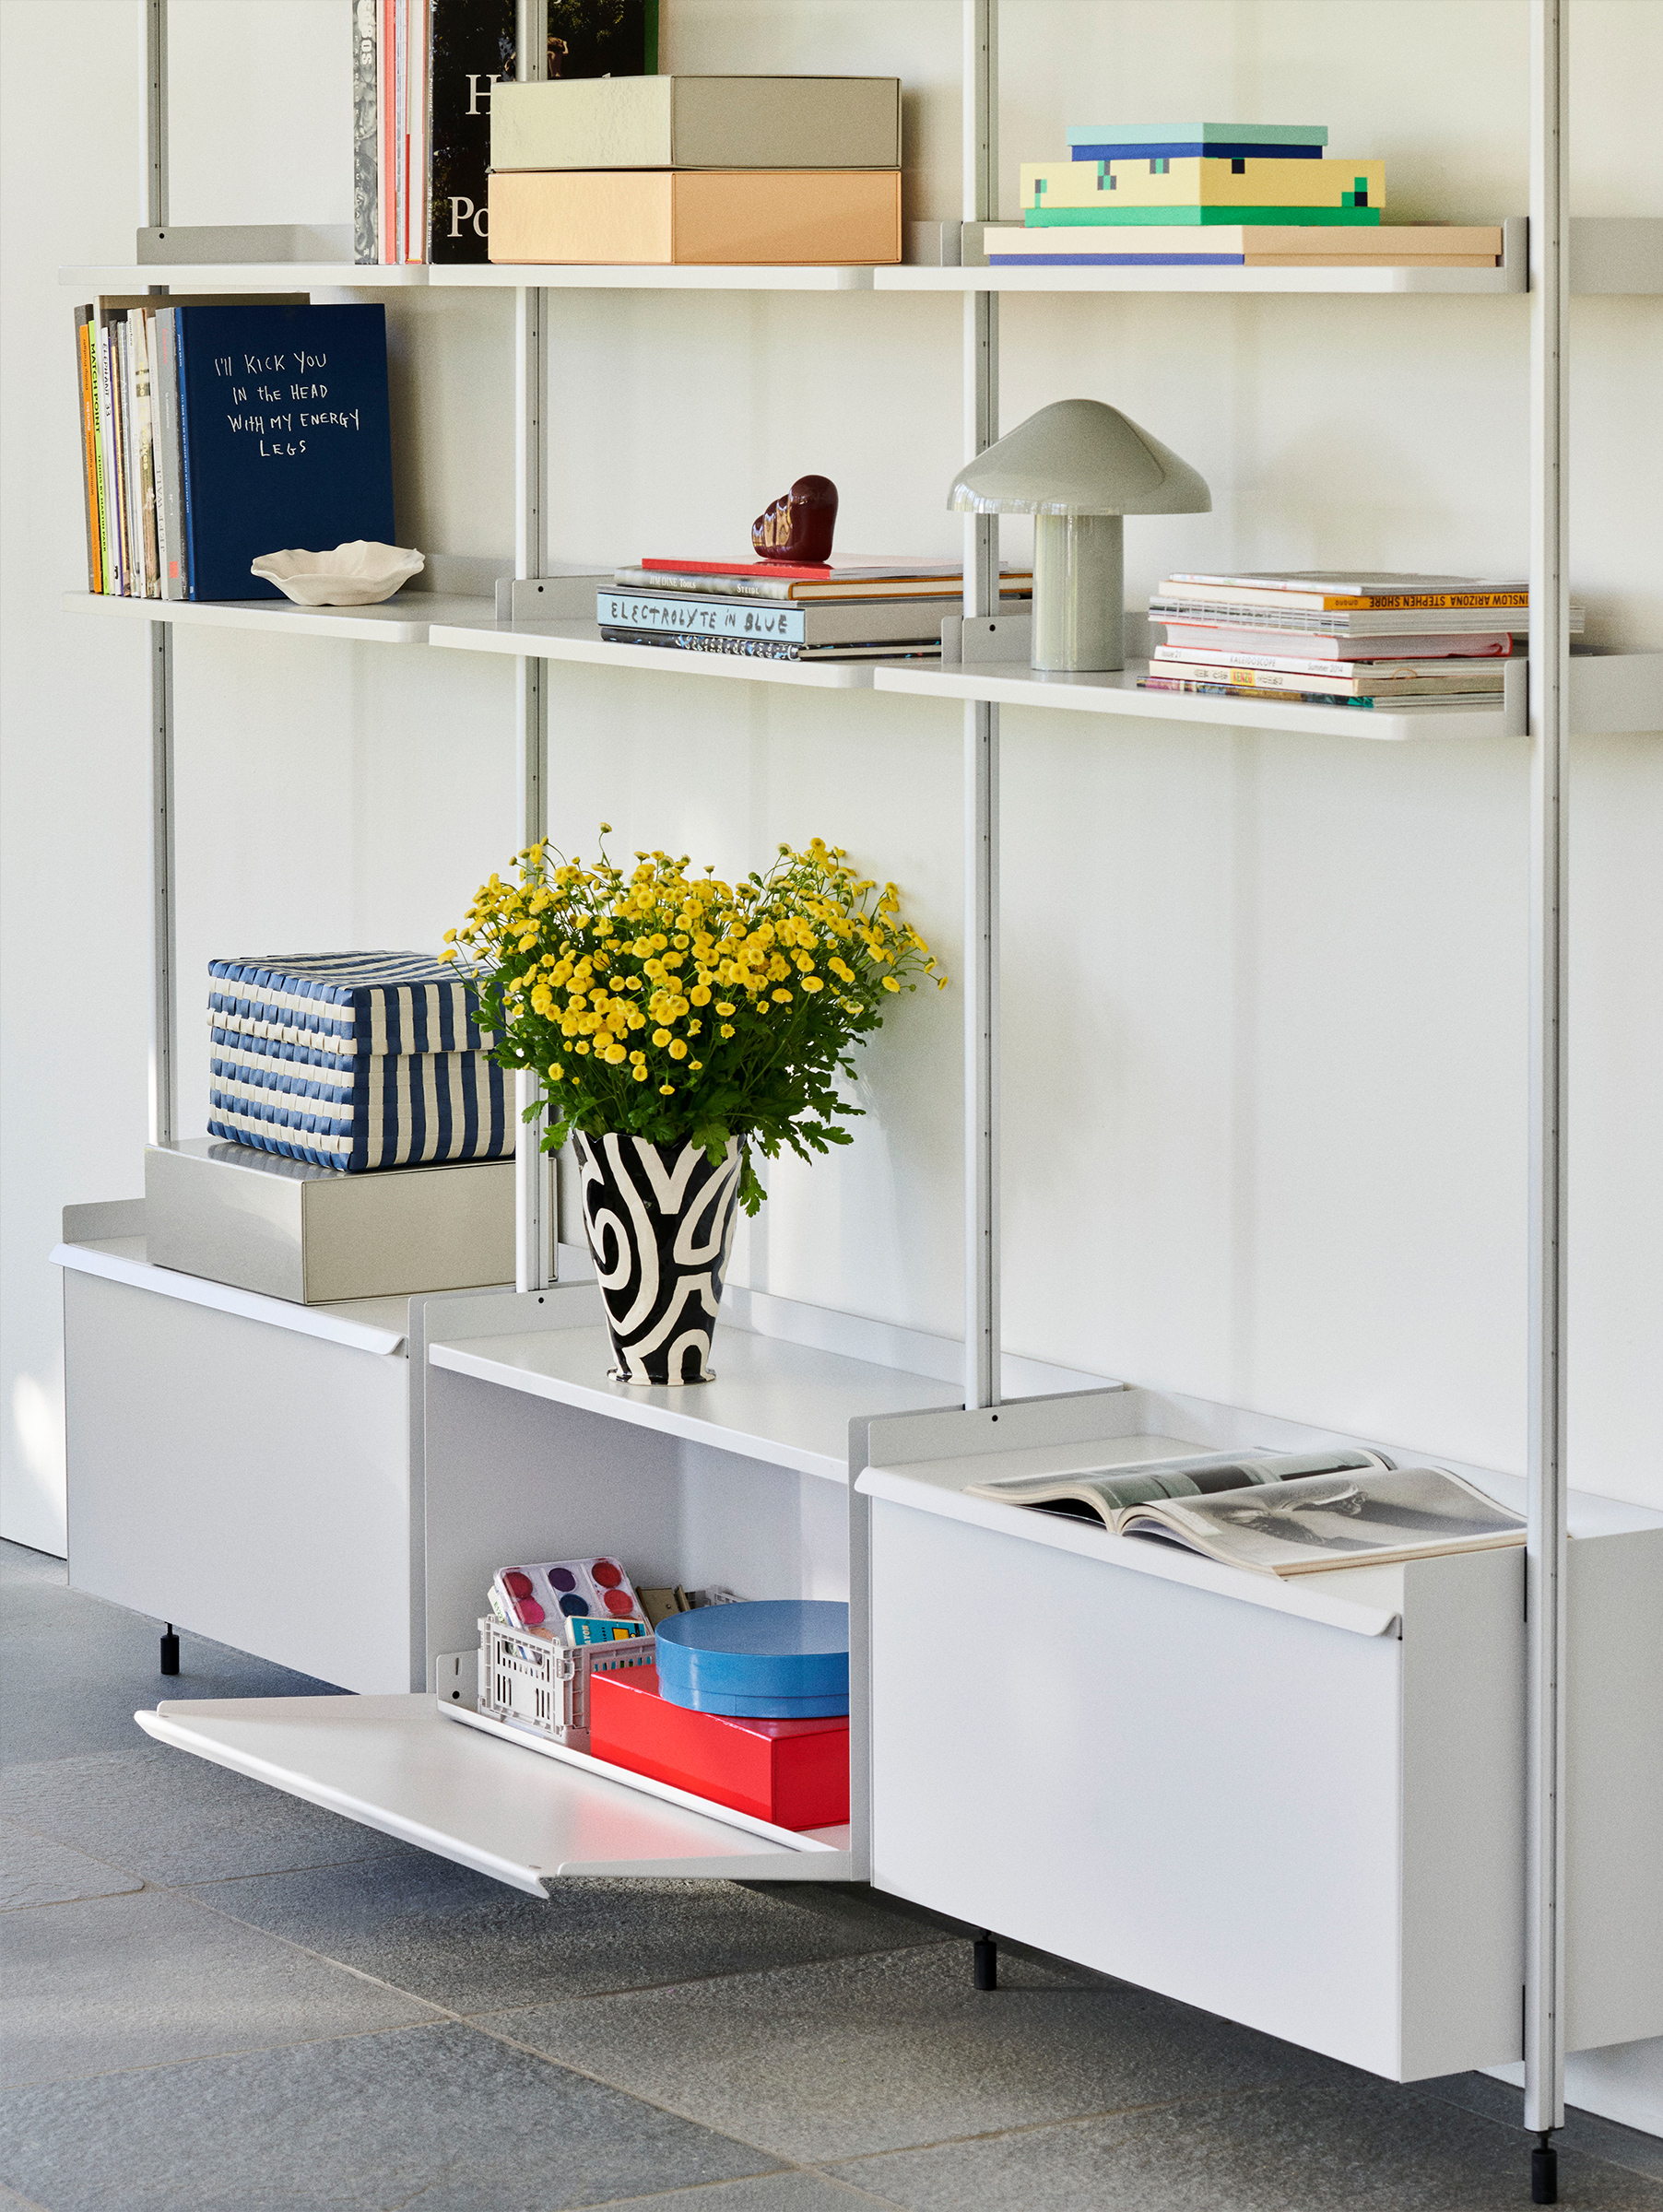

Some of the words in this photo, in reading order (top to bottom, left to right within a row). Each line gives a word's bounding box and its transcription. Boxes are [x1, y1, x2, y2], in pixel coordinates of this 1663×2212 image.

[244, 354, 286, 375] KICK
[293, 351, 327, 375] YOU
[101, 343, 110, 397] ELEPHANT
[232, 386, 247, 406] IN
[290, 384, 328, 400] HEAD
[105, 403, 111, 417] 33
[269, 414, 292, 430] MY
[300, 408, 360, 430] ENERGY
[259, 440, 307, 457] LEGS
[100, 486, 102, 495] BY
[649, 575, 661, 585] JIM
[662, 577, 678, 587] DINE
[1369, 597, 1401, 607] SHORE
[1403, 596, 1445, 607] STEPHEN
[1450, 595, 1491, 606] ARIZONA
[1492, 594, 1528, 606] INSLOW
[611, 600, 716, 629] ELECTROLYTE
[744, 613, 787, 633] BLUE
[1230, 655, 1276, 667] KALEIDOSCOPE
[1307, 663, 1329, 673] Summer
[1330, 665, 1344, 674] 2014
[1233, 671, 1253, 684] KENZO
[582, 1625, 591, 1644] AYON
